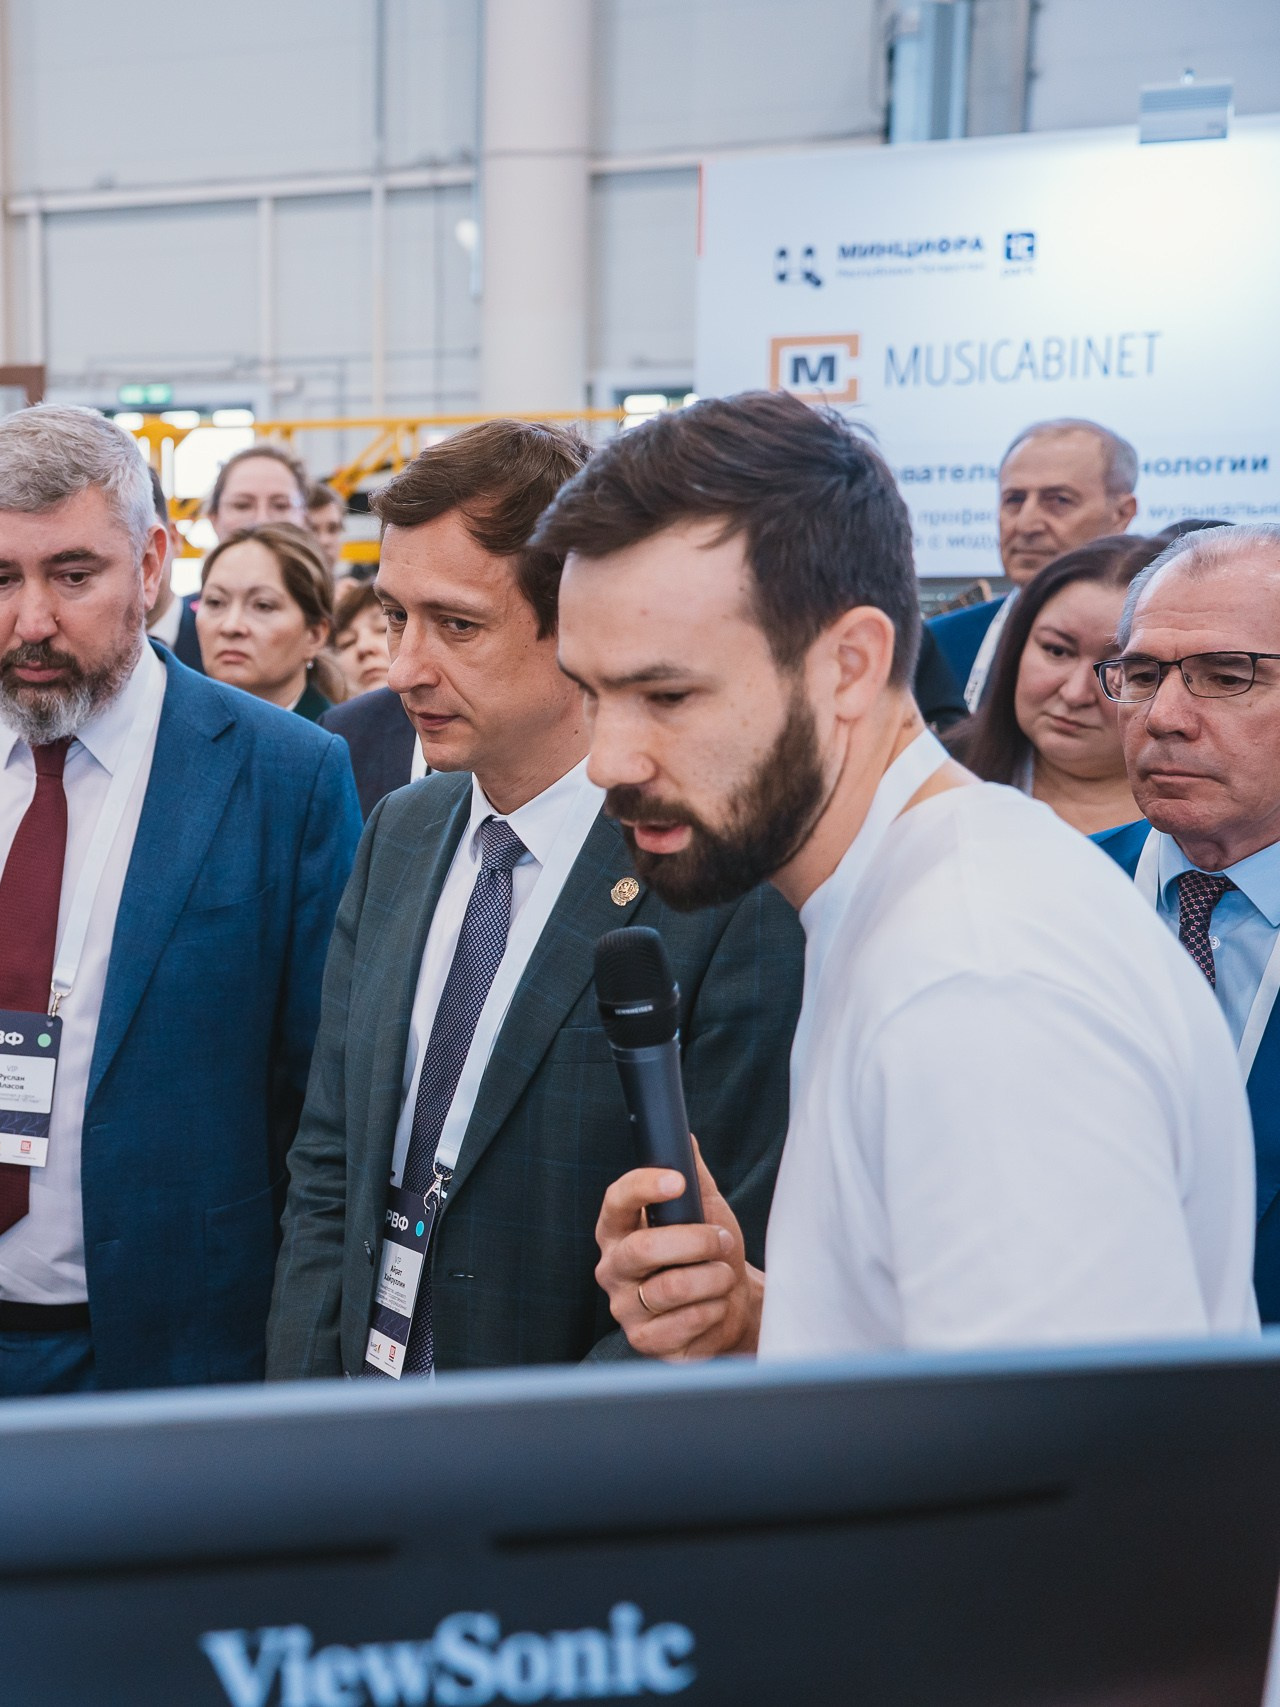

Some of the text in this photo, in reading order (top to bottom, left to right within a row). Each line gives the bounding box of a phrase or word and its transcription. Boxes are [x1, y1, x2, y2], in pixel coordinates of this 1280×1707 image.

[790, 354, 836, 385] M
[884, 331, 1163, 388] MUSICABINET
[385, 1208, 409, 1232] РВФ
[199, 1602, 697, 1707] ViewSonic
